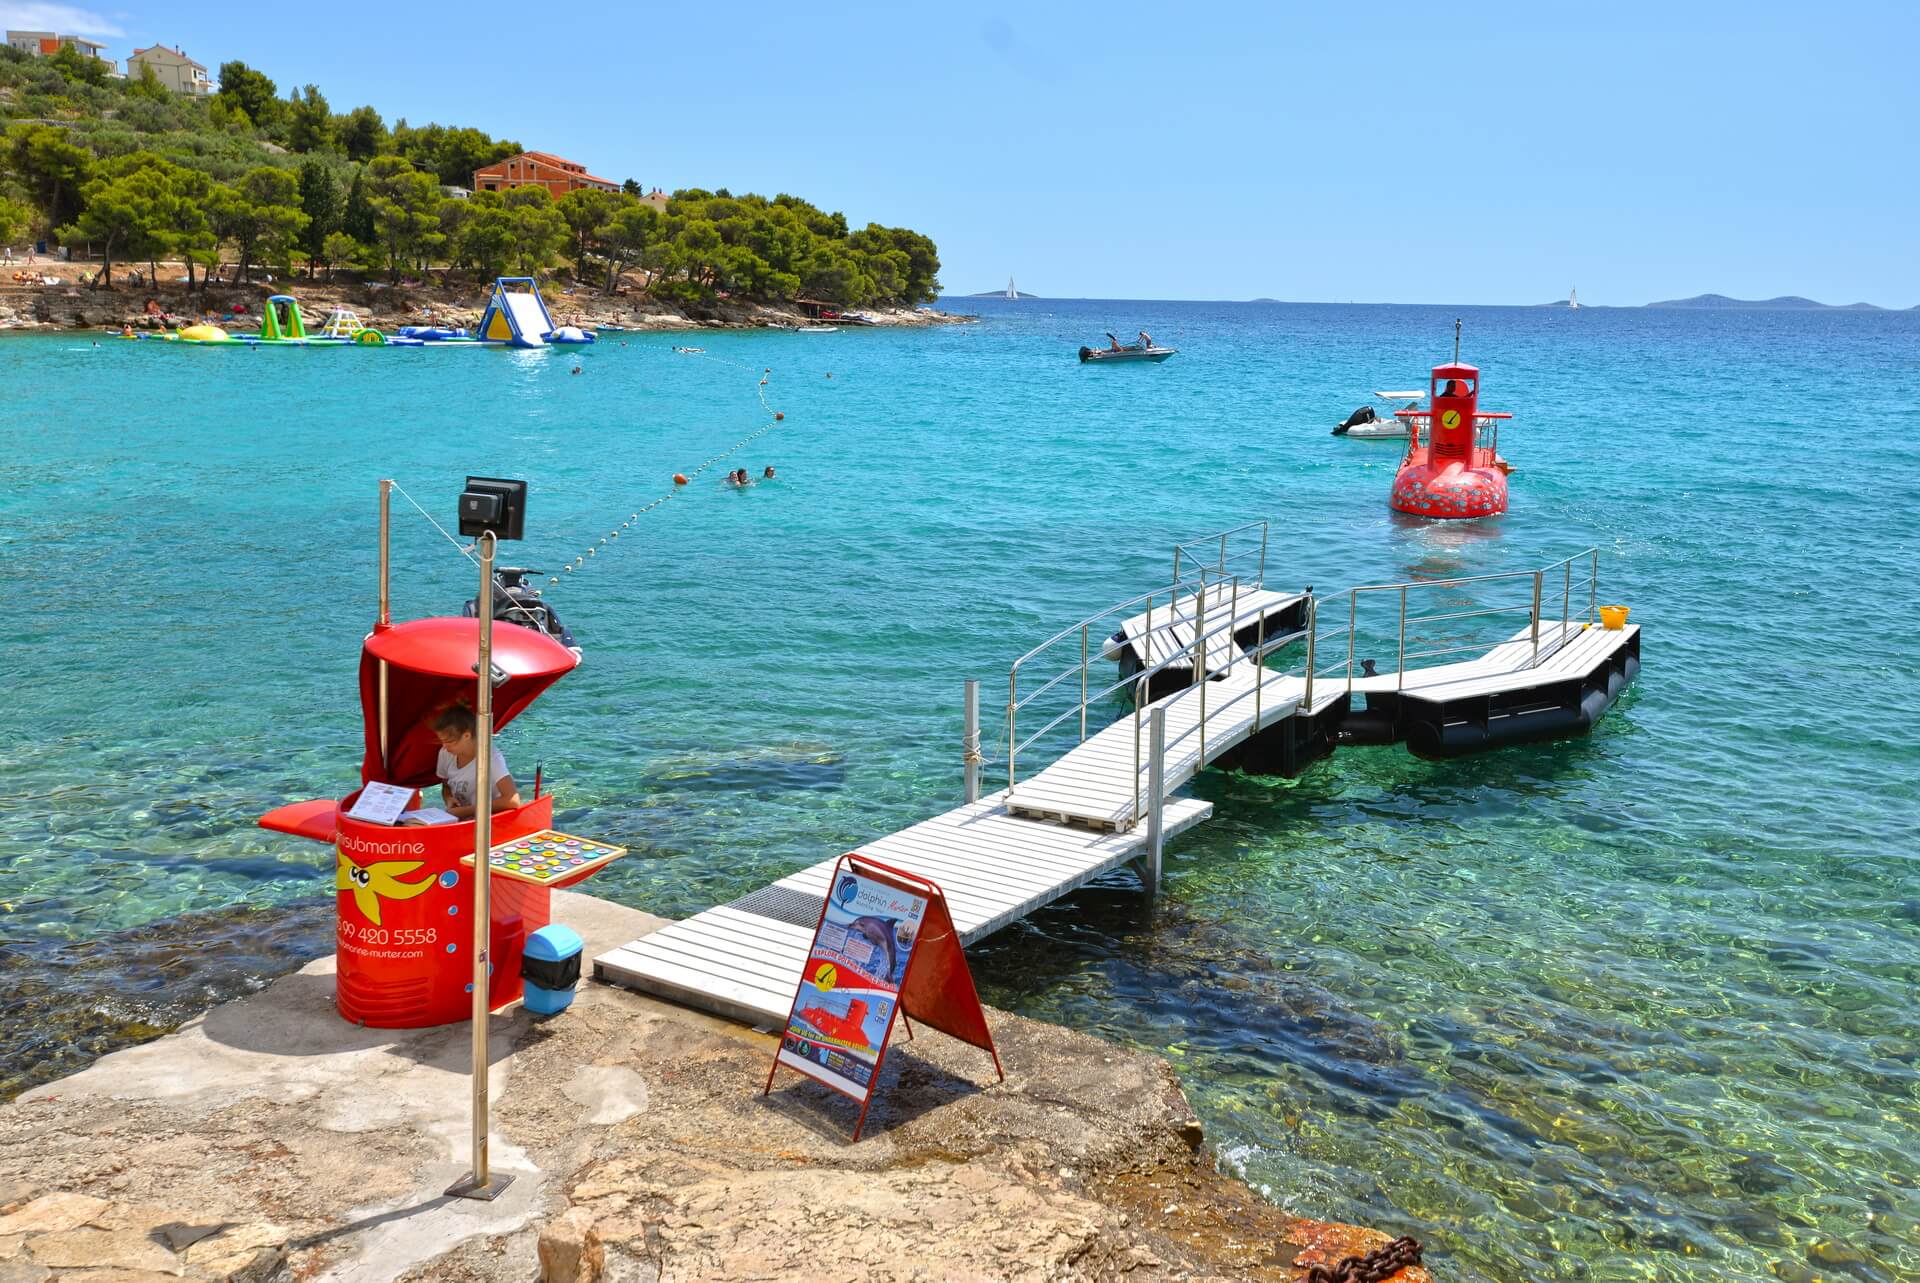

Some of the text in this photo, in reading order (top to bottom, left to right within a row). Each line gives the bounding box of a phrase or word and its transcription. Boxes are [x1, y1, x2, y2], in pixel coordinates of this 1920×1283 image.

[857, 890, 887, 907] dolphin
[358, 927, 389, 945] 420
[393, 927, 437, 945] 5558
